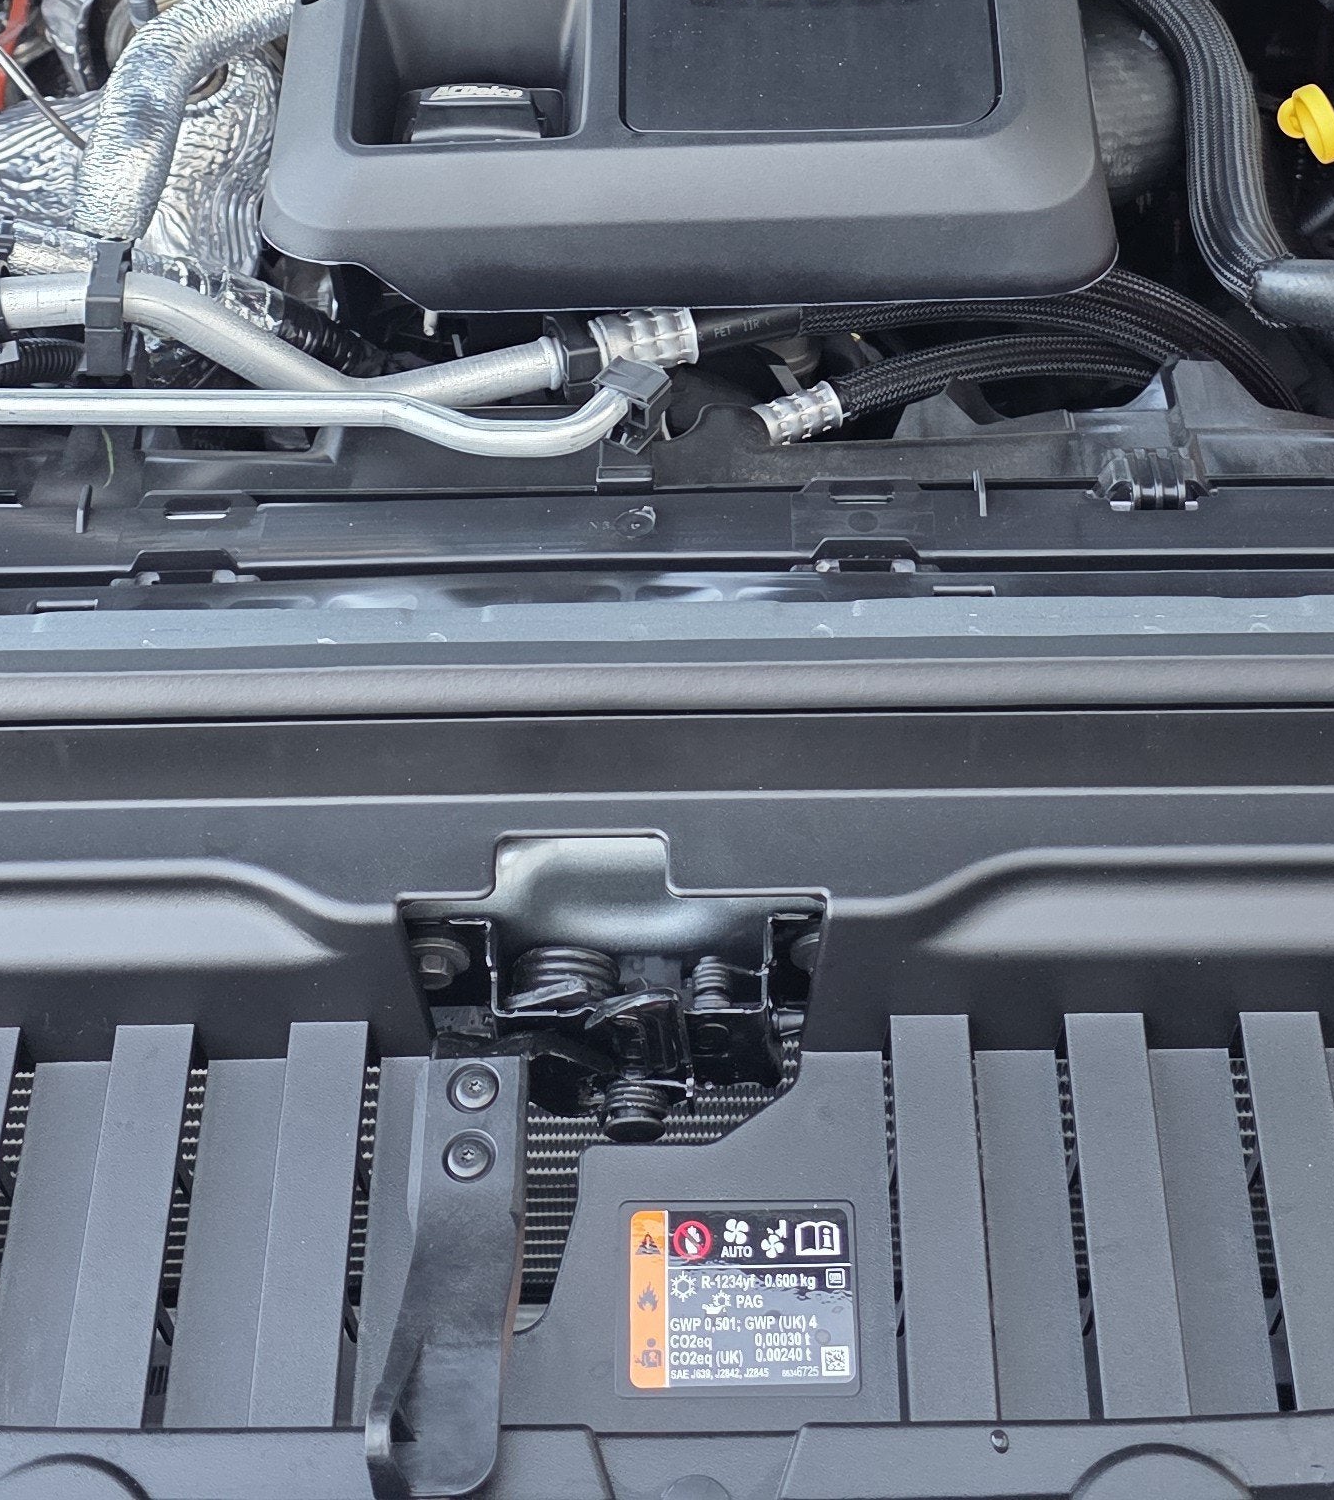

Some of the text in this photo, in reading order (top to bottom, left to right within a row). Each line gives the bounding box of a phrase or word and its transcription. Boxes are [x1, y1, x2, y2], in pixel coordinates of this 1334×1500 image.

[428, 85, 524, 101] ACDelco
[720, 1245, 753, 1259] AUTO
[701, 1273, 817, 1292] R-1234yf 0.600 kg
[735, 1294, 764, 1309] PAG
[669, 1314, 818, 1333] GWP 0,501; GWP (UK) 4
[669, 1331, 812, 1351] CO2eq 0,00030 t
[669, 1346, 813, 1368] CO2eq (UK) 0.00240 t
[670, 1369, 690, 1380] SAE
